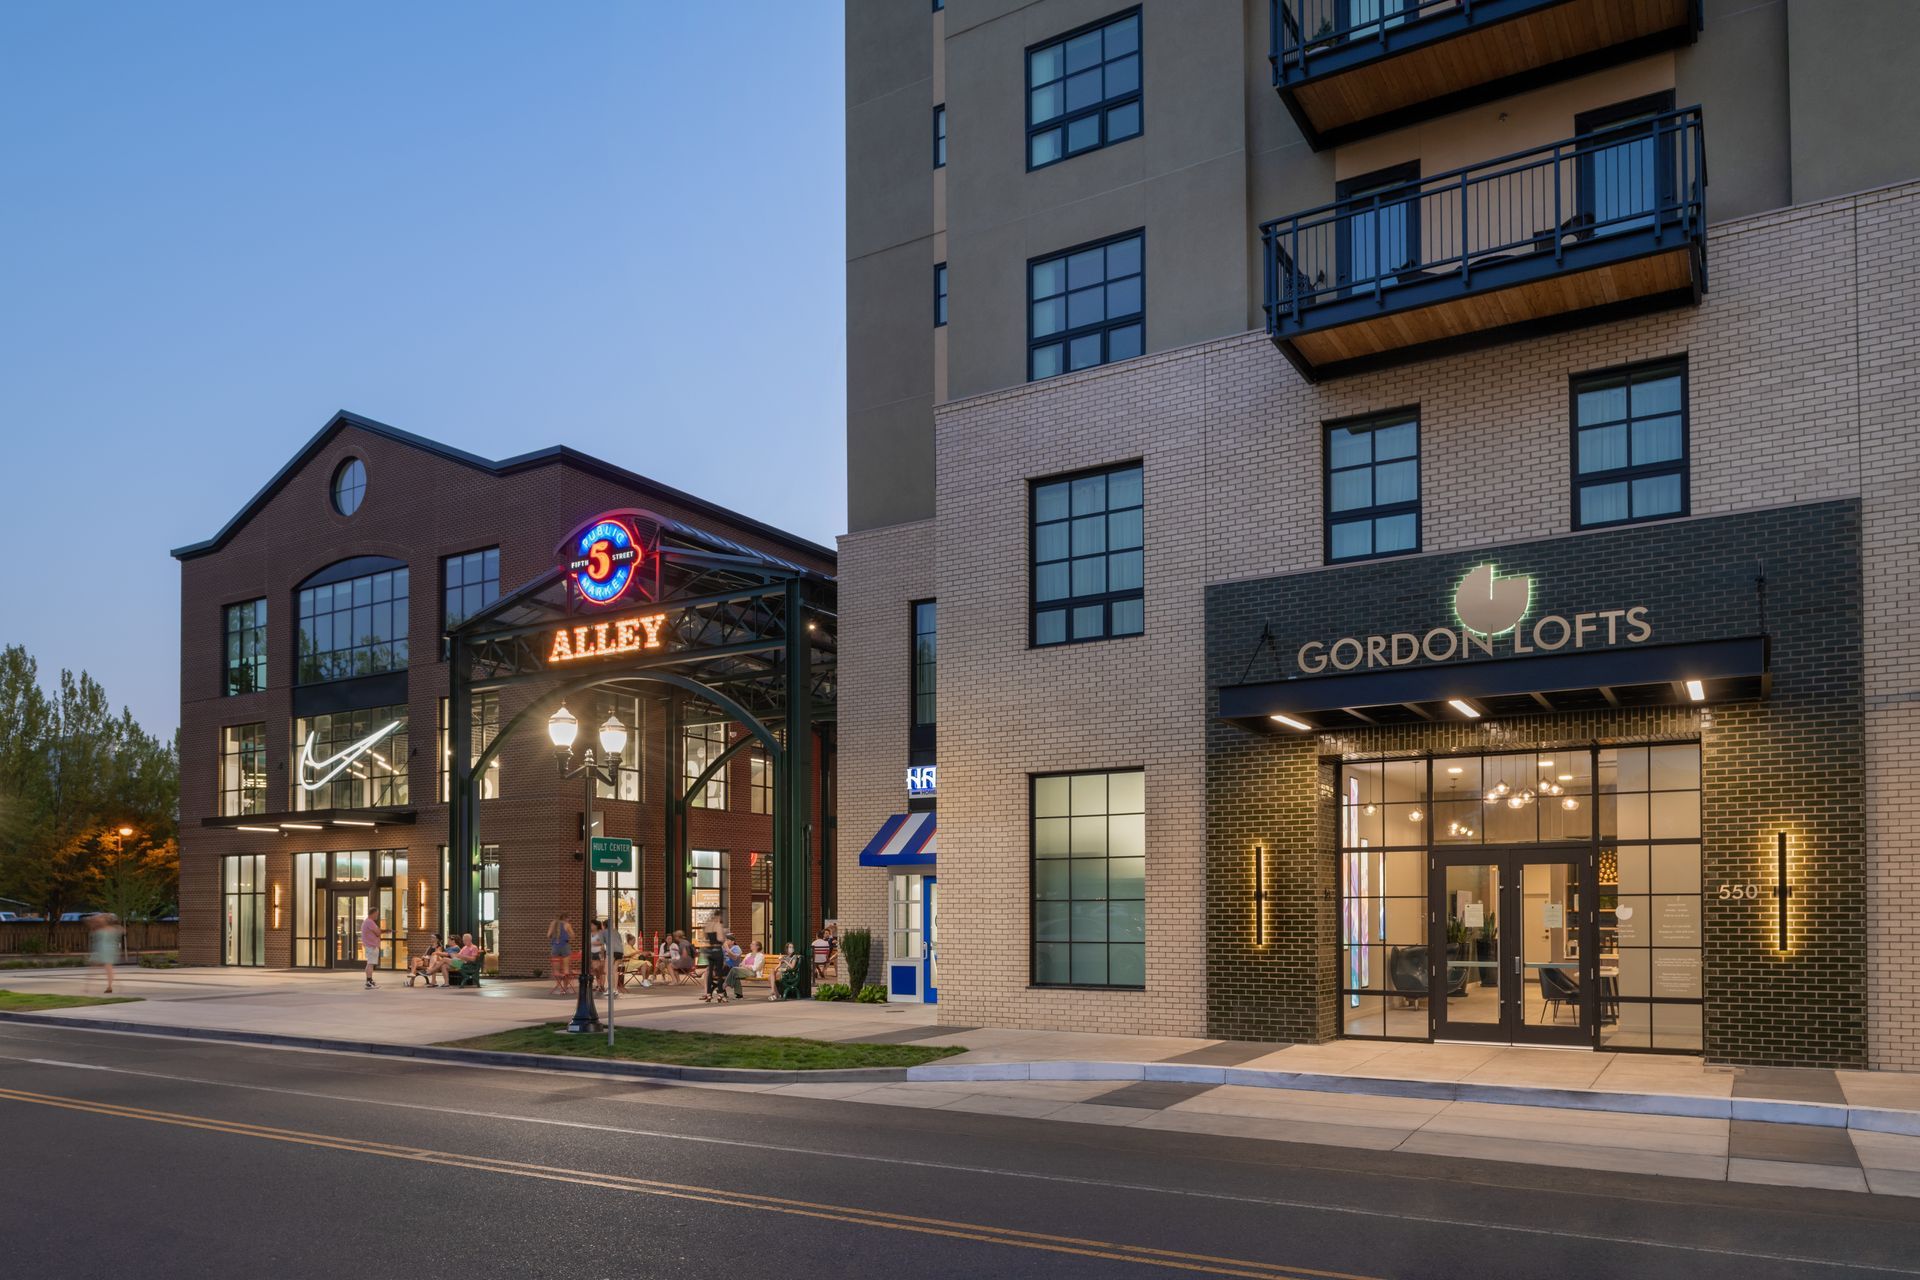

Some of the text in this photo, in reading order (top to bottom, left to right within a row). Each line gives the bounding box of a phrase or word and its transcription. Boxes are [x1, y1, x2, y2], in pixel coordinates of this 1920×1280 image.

[581, 525, 625, 548] PUBLIC
[571, 551, 634, 569] FIFTH STREET
[587, 541, 610, 579] 5
[581, 570, 625, 596] MARKET
[549, 614, 665, 662] ALLEY
[1297, 606, 1652, 674] GORDON LOFTS
[610, 842, 630, 852] CENTER
[1719, 884, 1758, 900] 550
